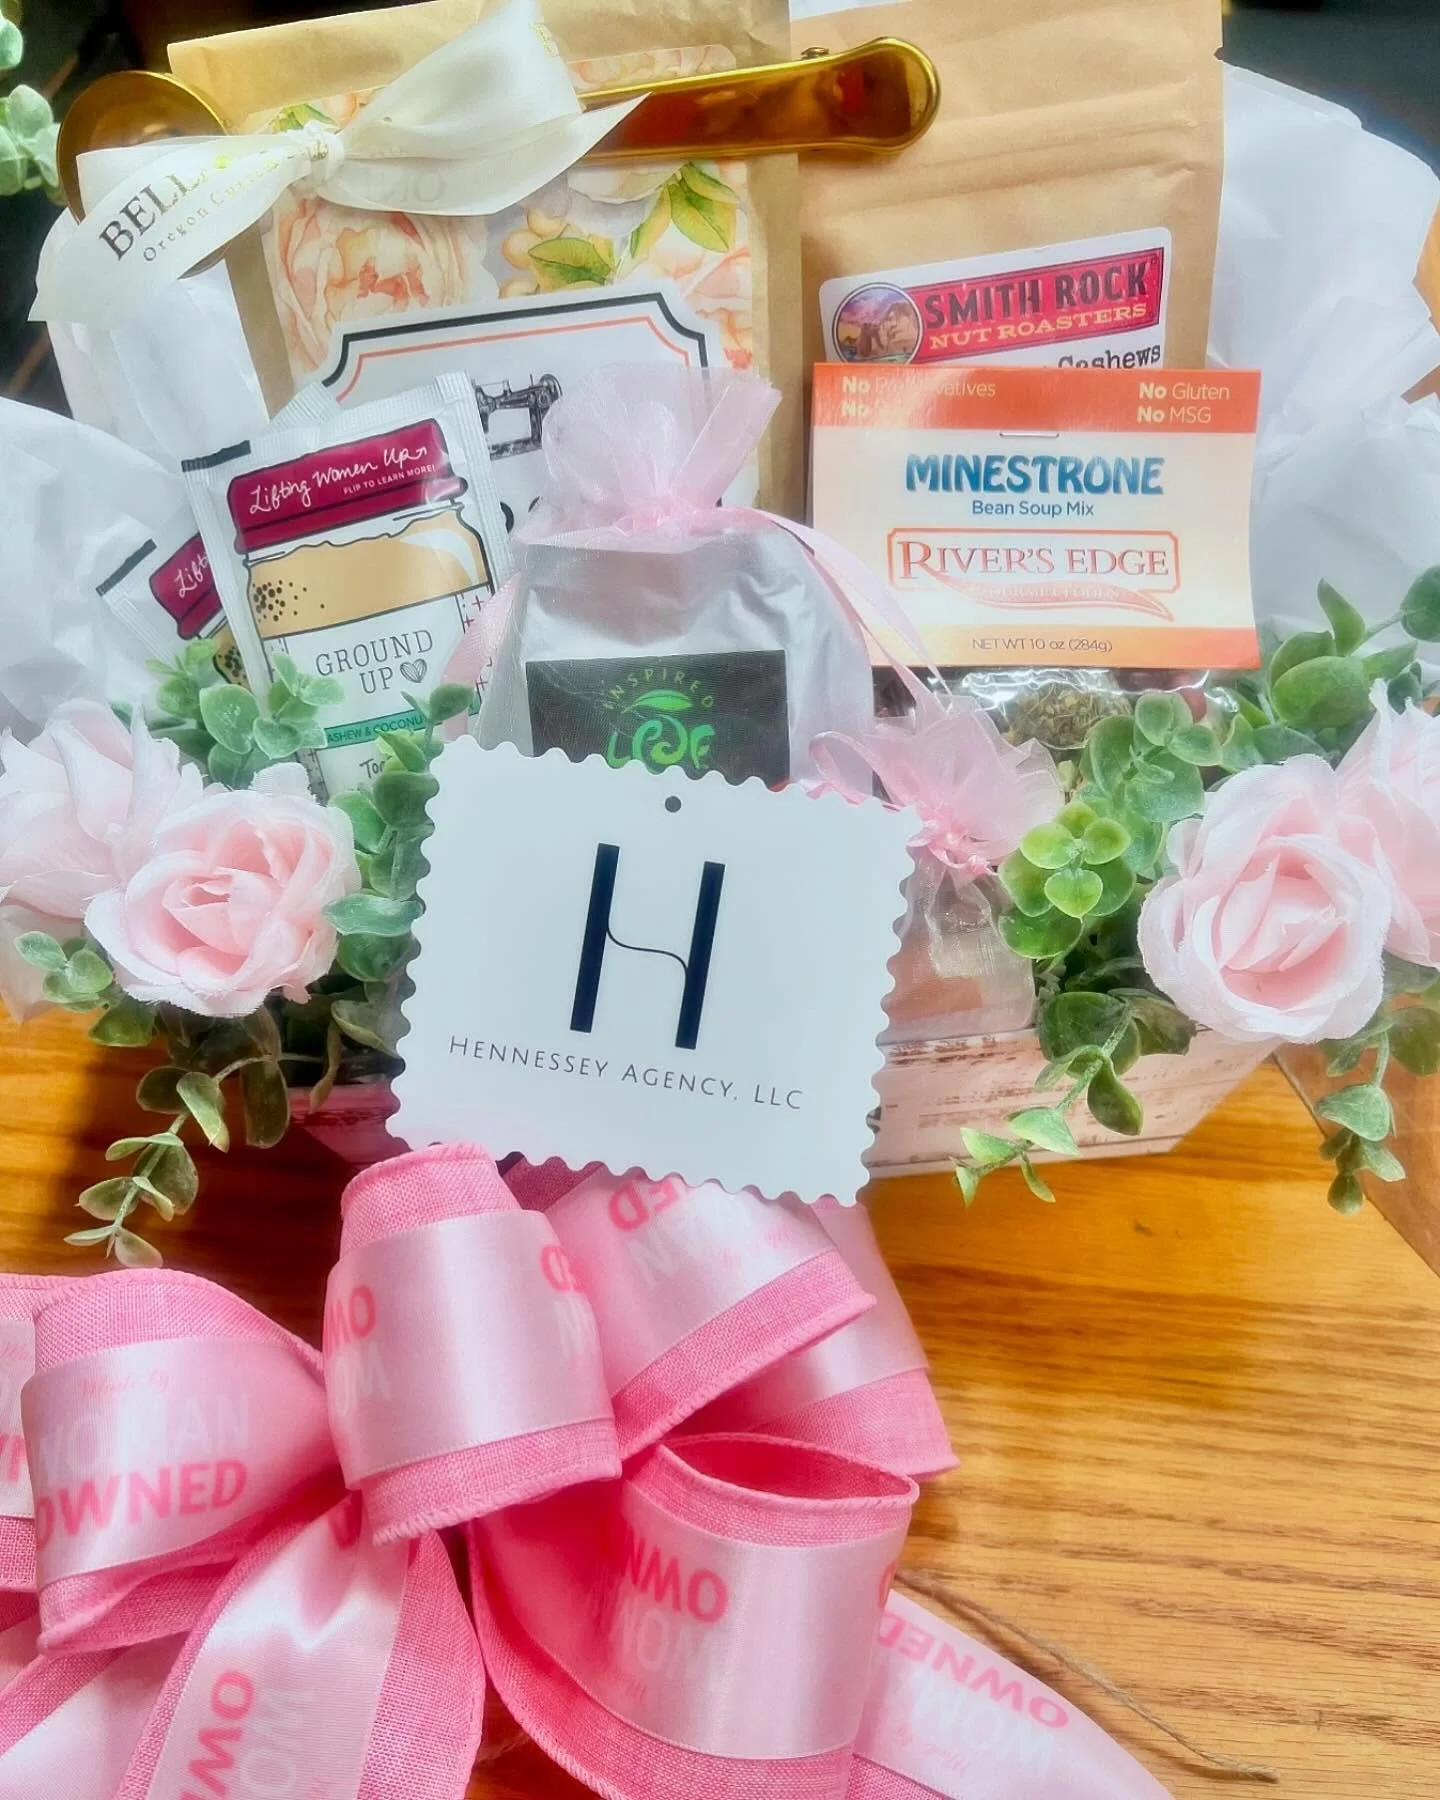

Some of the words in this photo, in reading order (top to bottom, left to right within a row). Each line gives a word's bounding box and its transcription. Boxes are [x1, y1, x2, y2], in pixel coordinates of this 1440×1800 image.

[924, 279, 1041, 329] SMITH
[1055, 261, 1149, 309] ROCK
[930, 327, 992, 350] NUT
[998, 302, 1147, 341] ROASTERS
[841, 376, 870, 393] No
[1138, 382, 1167, 399] No
[1171, 382, 1230, 400] Gluten
[841, 402, 868, 418] No
[1137, 405, 1165, 423] No
[1169, 406, 1212, 423] MSG
[249, 480, 312, 514] Lifting
[312, 463, 378, 488] Women
[383, 447, 424, 469] Up
[343, 484, 361, 495] FLIP
[363, 480, 376, 490] TO
[377, 473, 405, 487] LEARN
[407, 464, 436, 477] MORE!
[905, 453, 1166, 495] MINESTRONE
[971, 500, 1015, 516] Bean
[1018, 501, 1062, 518] Soup
[1066, 502, 1095, 516] Mix
[896, 540, 1055, 580] RIVER'S
[1066, 549, 1169, 576] EDGE
[315, 629, 434, 677] GROUND
[971, 638, 999, 650] NET
[1002, 639, 1026, 650] WT
[1029, 638, 1045, 650] 10
[1049, 640, 1065, 651] oz
[1068, 638, 1113, 652] (284g)
[360, 666, 394, 694] UP
[326, 728, 363, 743] ASHEW
[373, 714, 425, 734] COCONU
[569, 842, 726, 1050] H
[449, 1035, 609, 1078] HENNESSEY
[753, 1084, 805, 1110] LLC
[36, 1459, 249, 1551] OWNED
